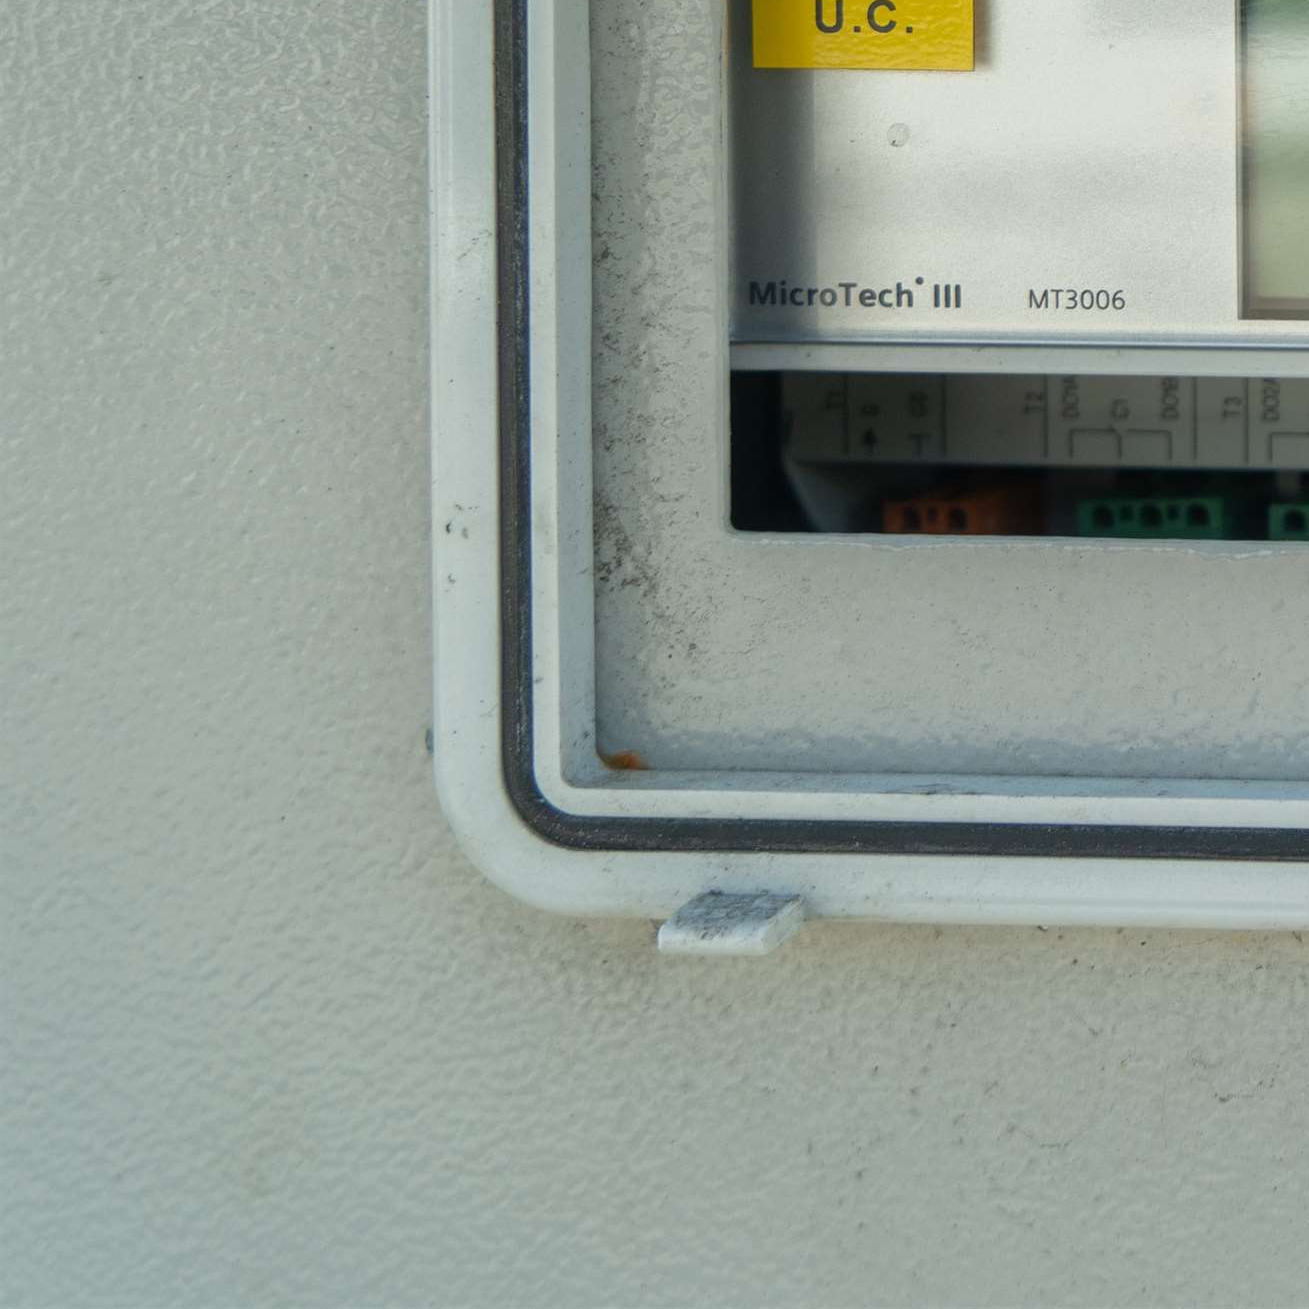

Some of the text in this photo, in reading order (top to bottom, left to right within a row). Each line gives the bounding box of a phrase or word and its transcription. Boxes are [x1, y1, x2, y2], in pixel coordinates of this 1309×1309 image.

[933, 284, 962, 308] III
[1028, 288, 1126, 311] MT3006
[1221, 395, 1243, 421] T3
